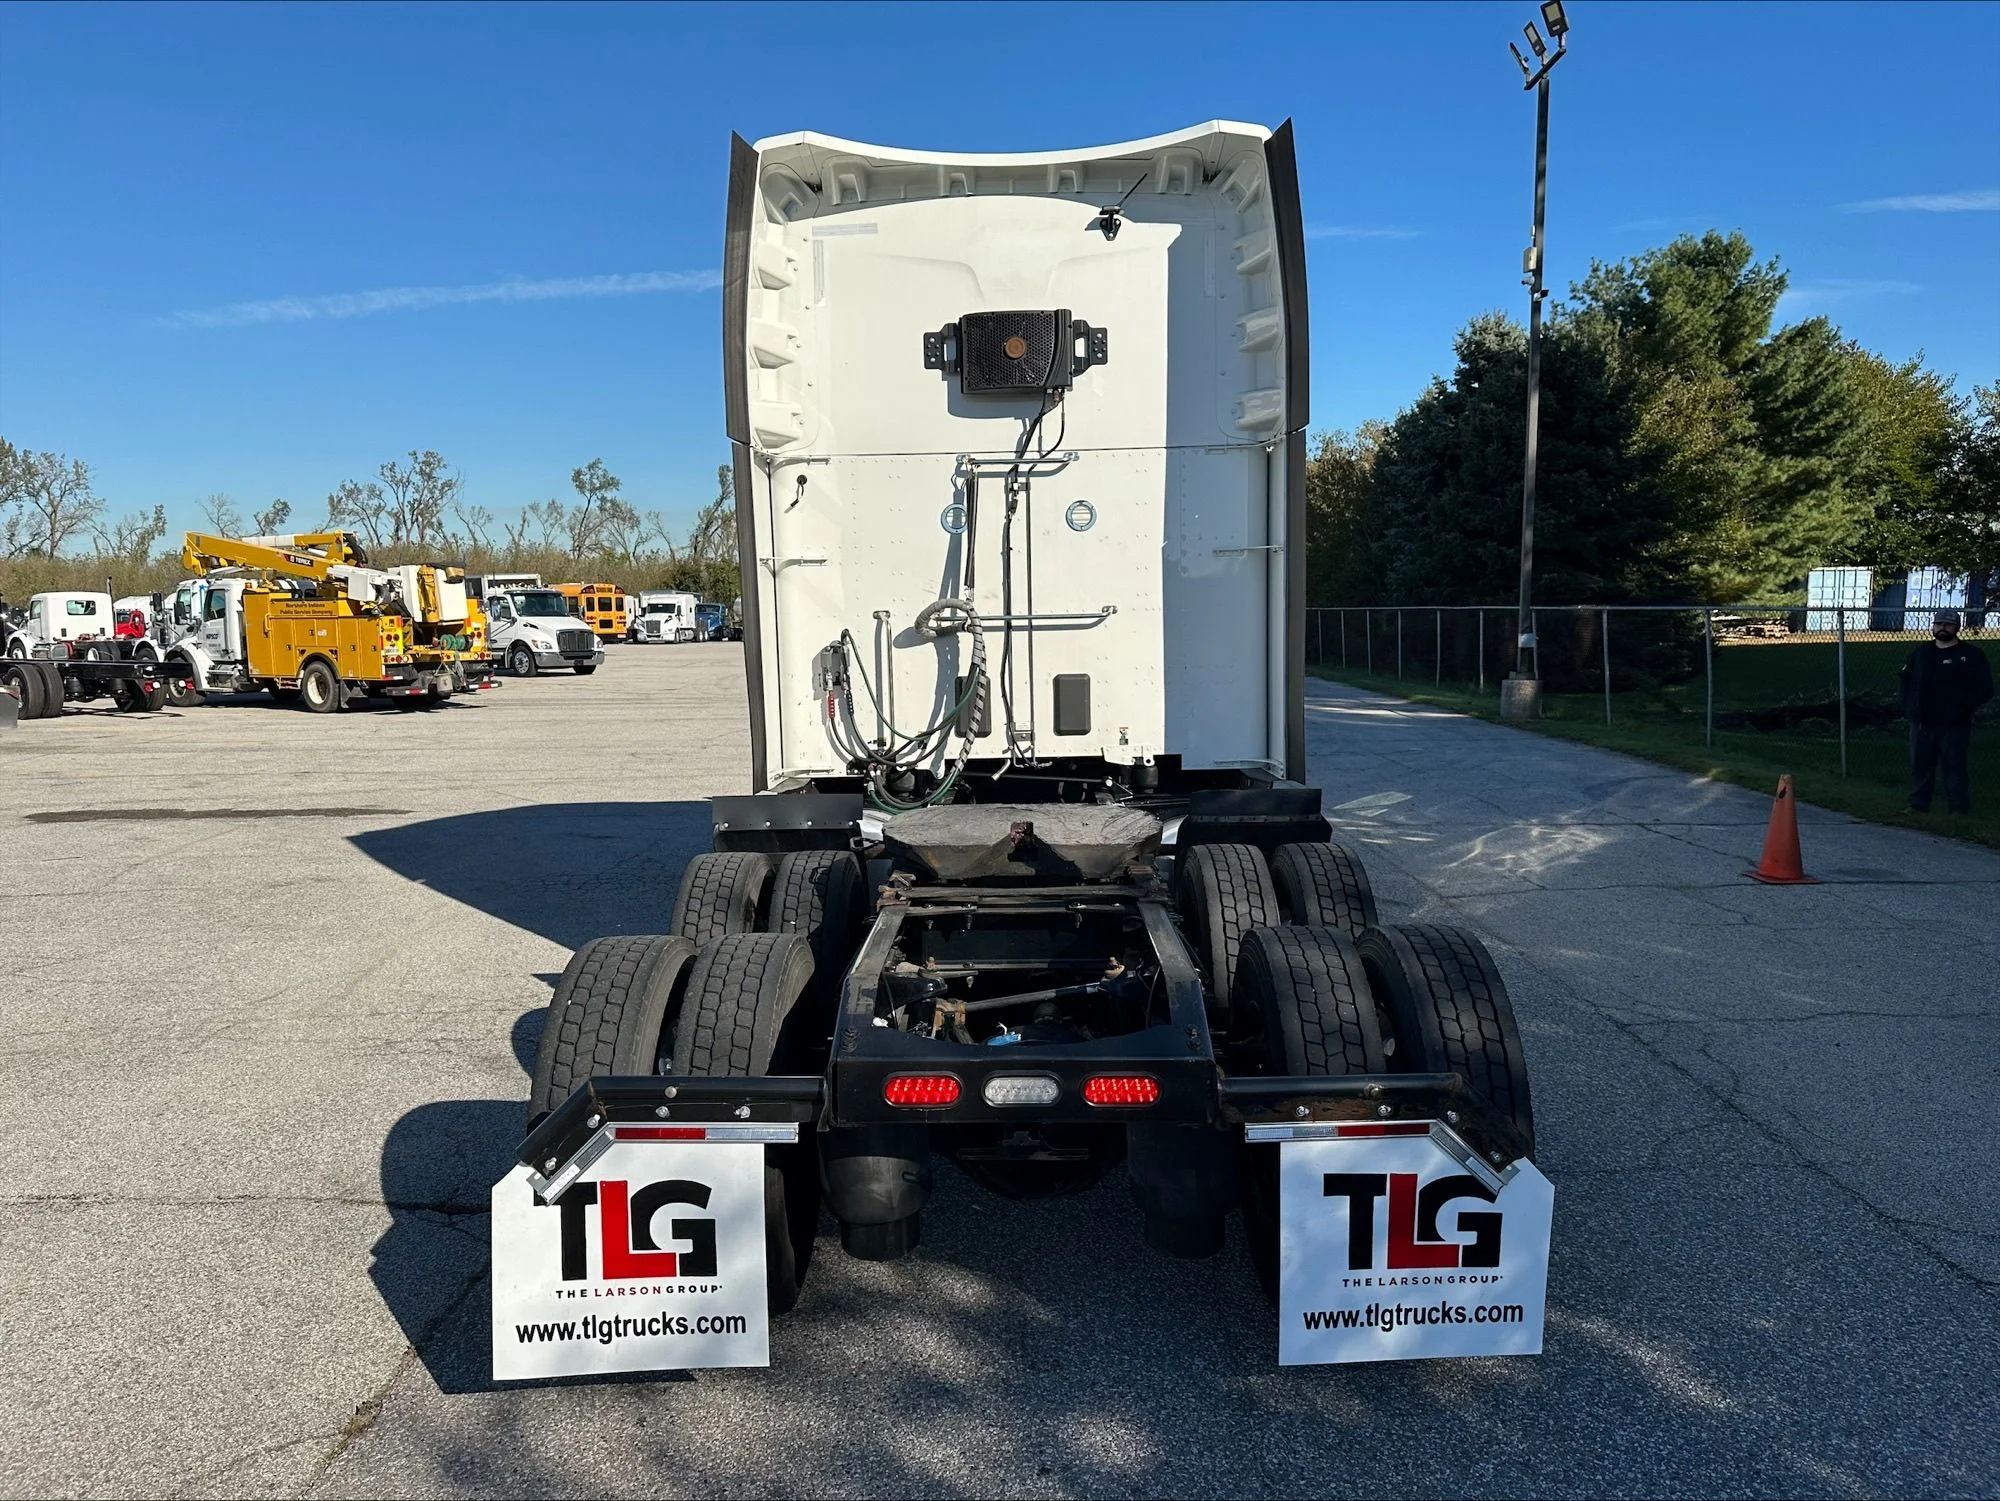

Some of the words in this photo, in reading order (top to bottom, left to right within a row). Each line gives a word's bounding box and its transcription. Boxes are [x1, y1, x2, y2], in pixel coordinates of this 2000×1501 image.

[533, 1179, 718, 1281] TLG
[1323, 1173, 1503, 1270] TLG
[556, 1289, 588, 1299] THE
[594, 1286, 662, 1297] LARSON
[666, 1284, 719, 1294] GROUP
[1342, 1278, 1372, 1287] THE
[1379, 1277, 1442, 1286] LARSON
[1448, 1275, 1500, 1284] GROUP
[516, 1311, 747, 1344] www.tlgtrucks.com
[1303, 1301, 1523, 1332] www.tlgtrucks.com
